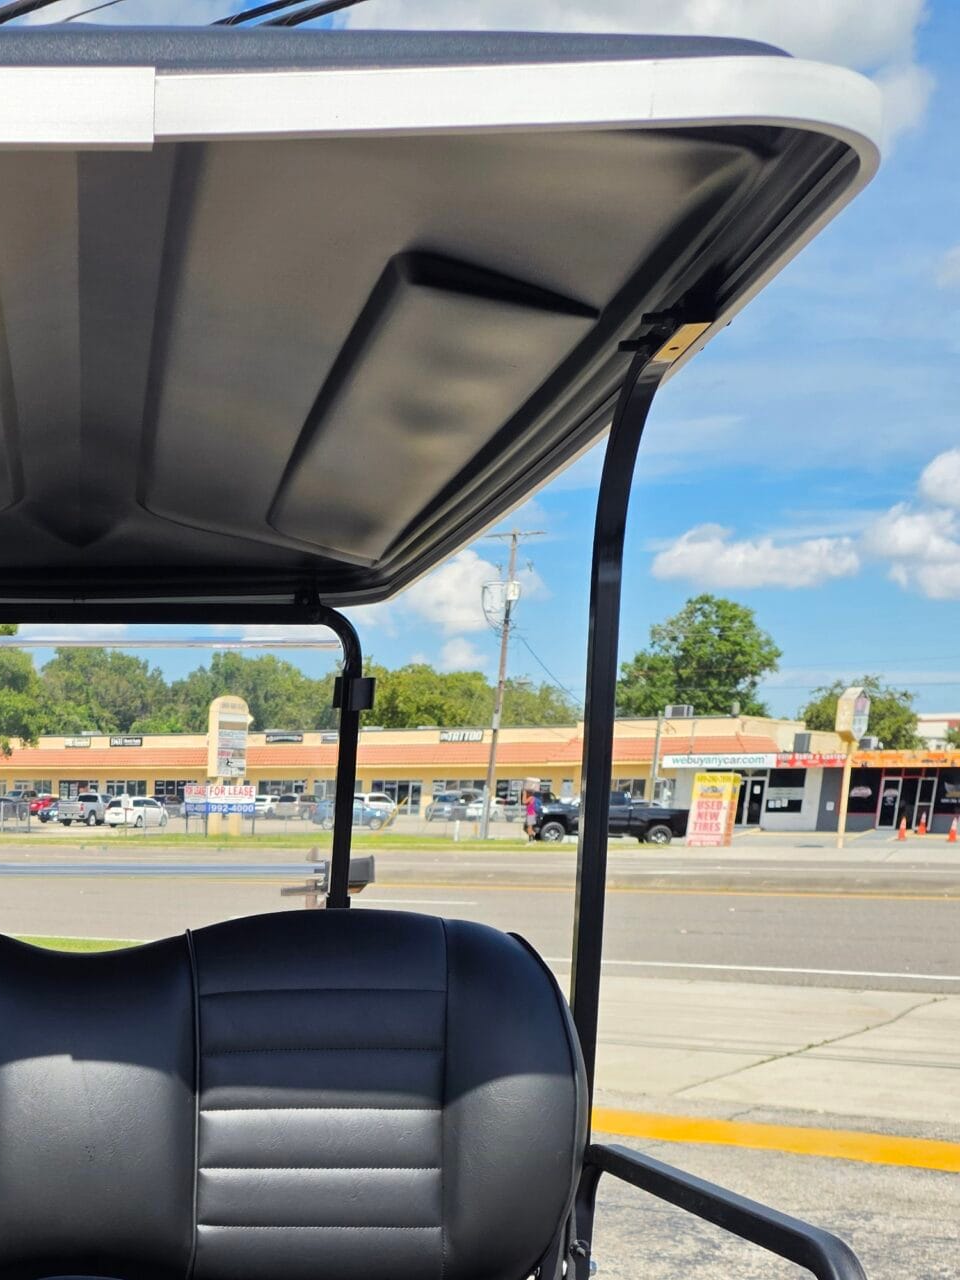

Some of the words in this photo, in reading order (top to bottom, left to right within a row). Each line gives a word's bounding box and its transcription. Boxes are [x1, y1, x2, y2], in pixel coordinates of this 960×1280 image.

[672, 755, 765, 767] webuyanycar.com
[209, 786, 226, 796] FOR
[228, 786, 254, 797] LEASE
[697, 800, 723, 810] USED
[696, 811, 720, 821] NEW
[693, 822, 721, 832] TIRES
